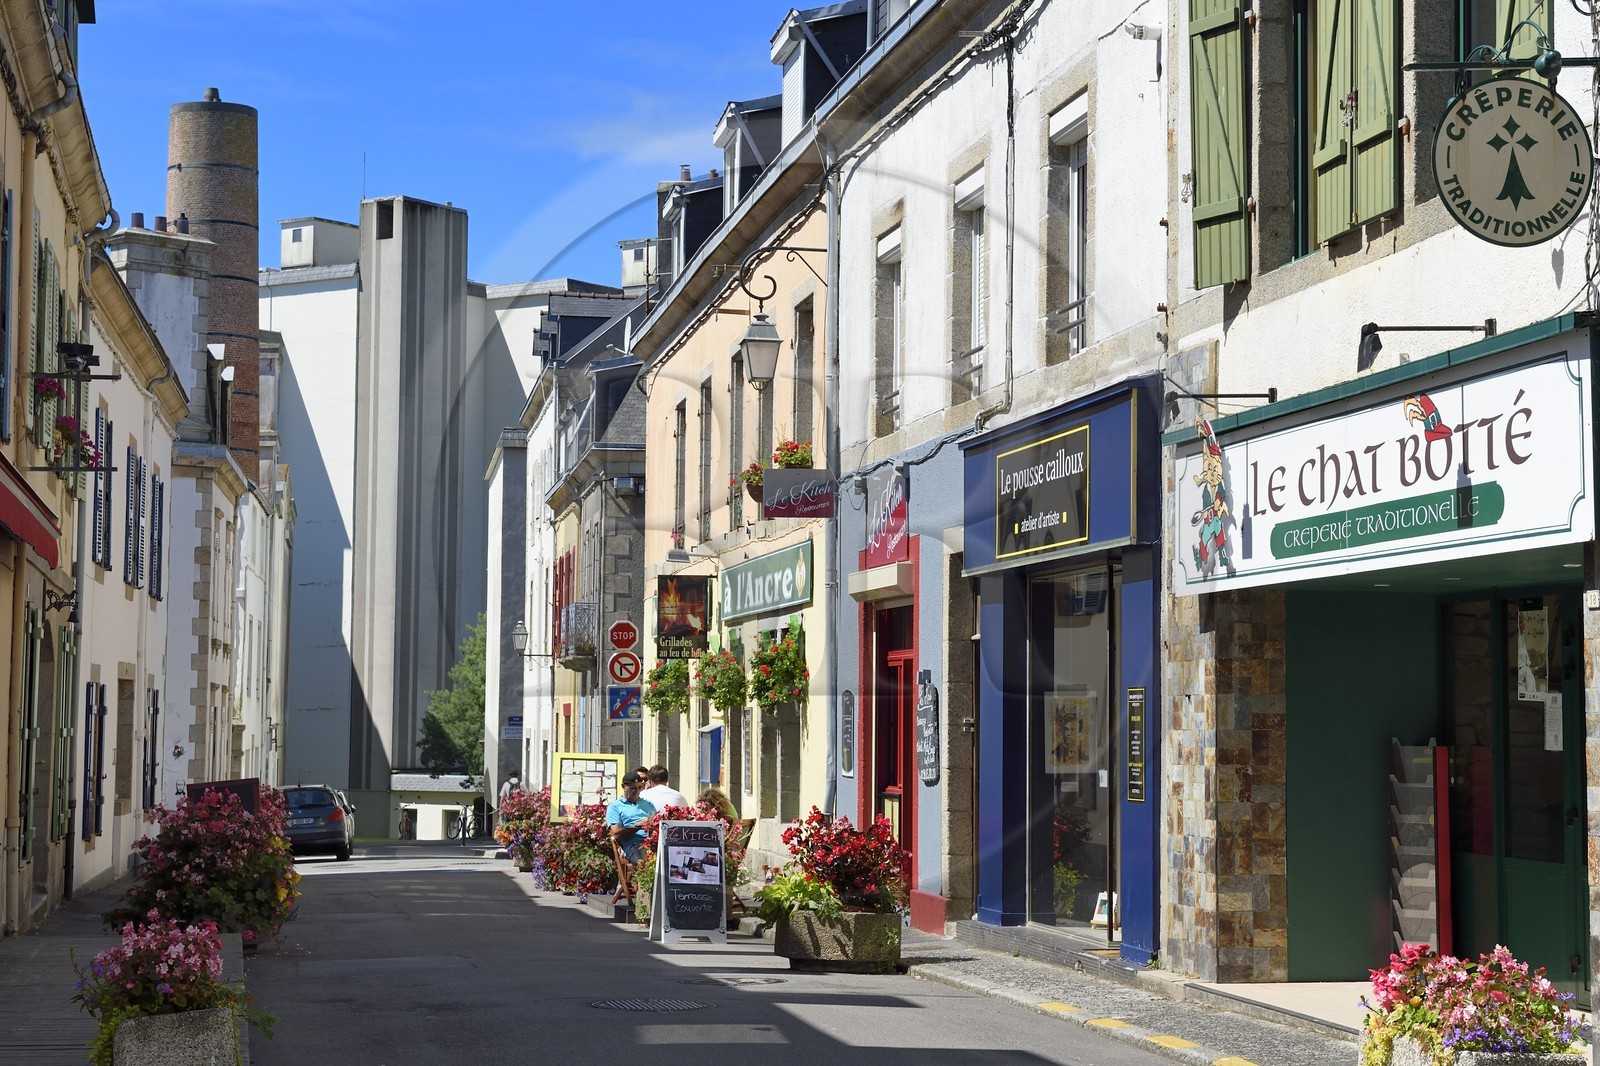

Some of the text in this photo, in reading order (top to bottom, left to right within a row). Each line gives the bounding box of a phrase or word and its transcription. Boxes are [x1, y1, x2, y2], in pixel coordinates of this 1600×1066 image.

[1446, 87, 1578, 141] CRÊPERIE
[1443, 171, 1586, 237] TRADITIONNELLE
[1251, 389, 1533, 516] LE CHAT BOTTÉ
[1000, 448, 1083, 499] Le pousse cailloux
[765, 480, 831, 511] Le Kitch
[795, 501, 830, 515] Restaurant
[1020, 510, 1060, 532] atelier d'artiste
[1284, 495, 1479, 549] CREPERIE TRADITIONELLE
[724, 567, 793, 614] à l'Ancre
[612, 631, 635, 640] STOP
[659, 635, 693, 647] Grillades
[669, 647, 680, 657] feu
[681, 647, 689, 657] de
[682, 828, 717, 841] KITCH
[670, 888, 715, 902] Terrasse
